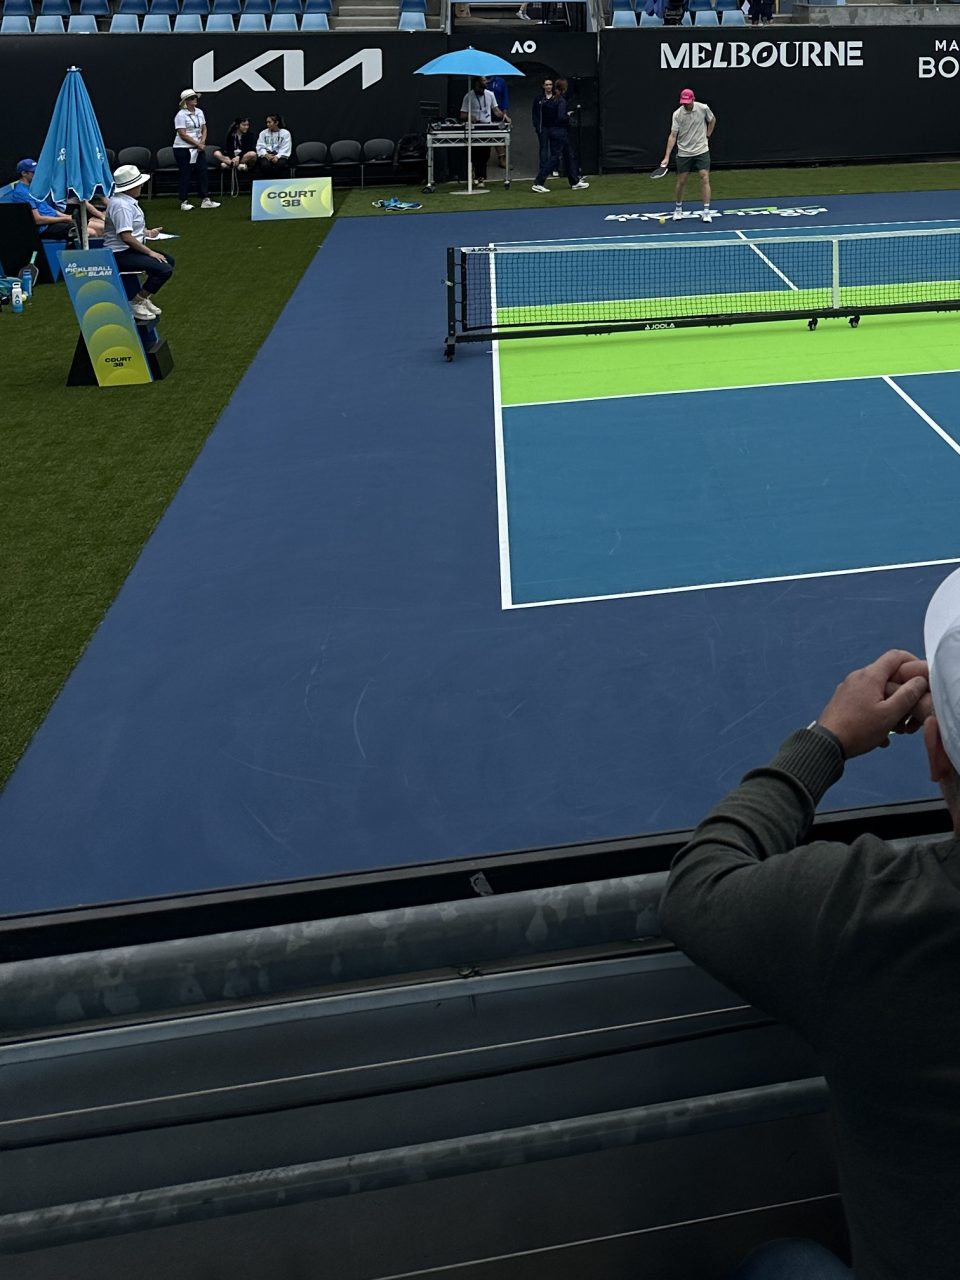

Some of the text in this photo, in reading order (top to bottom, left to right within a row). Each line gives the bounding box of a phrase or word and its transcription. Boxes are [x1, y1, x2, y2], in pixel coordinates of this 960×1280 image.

[511, 40, 537, 53] AO
[661, 41, 864, 69] MELBOURNE
[267, 190, 316, 199] COURT
